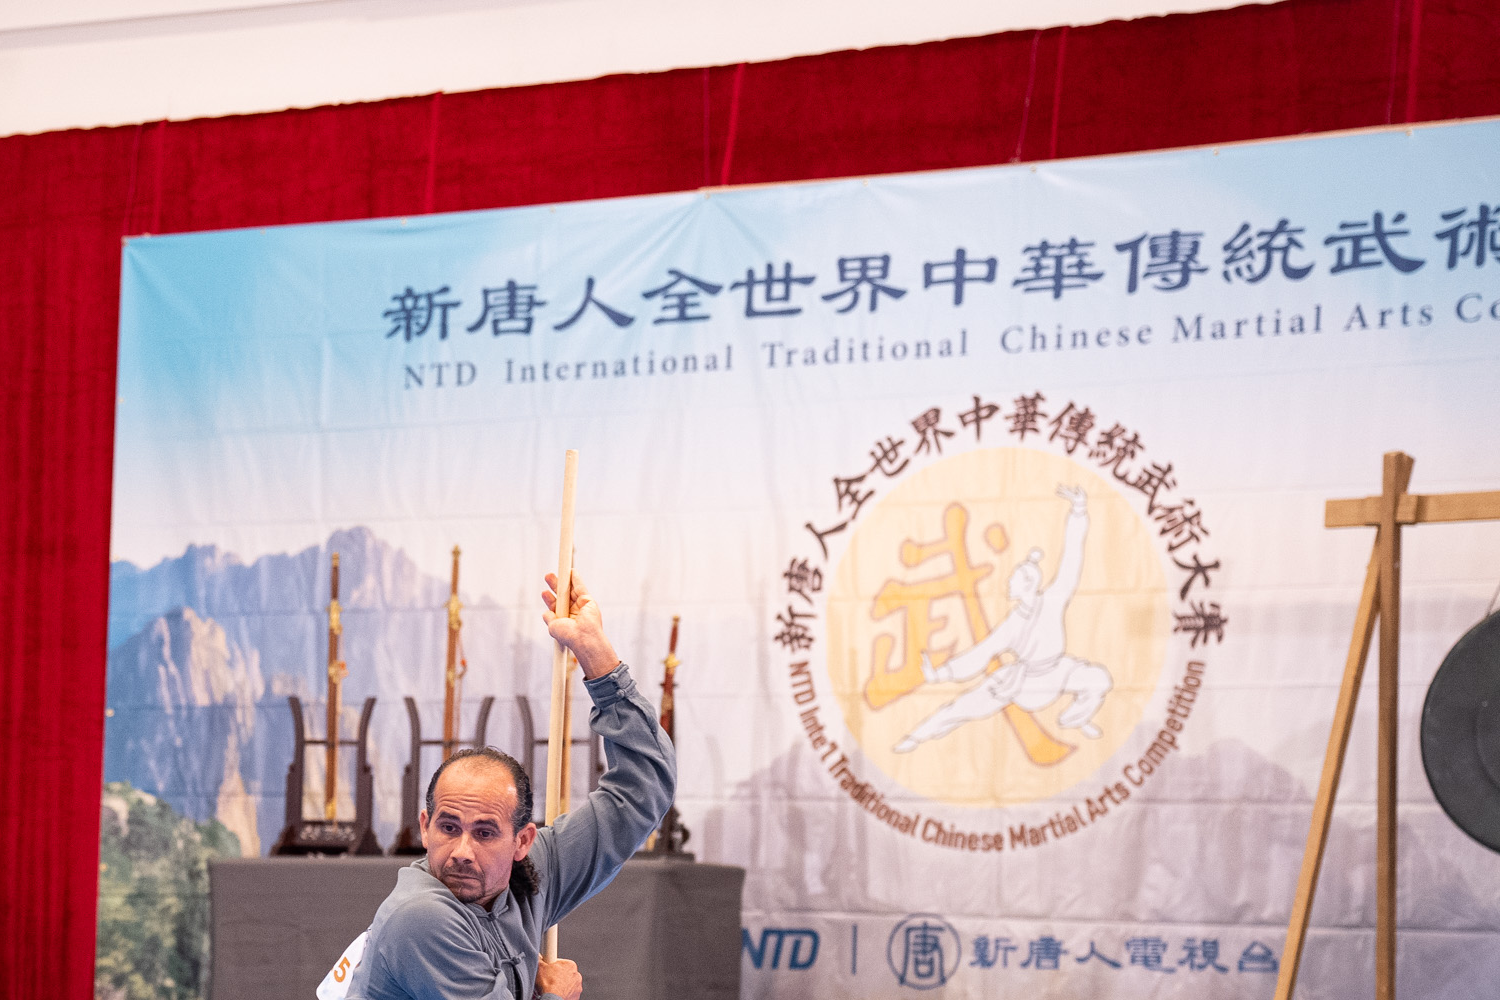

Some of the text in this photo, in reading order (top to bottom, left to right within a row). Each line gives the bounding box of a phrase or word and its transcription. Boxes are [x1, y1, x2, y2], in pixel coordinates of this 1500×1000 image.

[382, 202, 1500, 342] 新唐人全世界中華傳統武術
[403, 361, 478, 390] NTD
[504, 345, 734, 384] International
[762, 329, 969, 369] Traditional
[1000, 323, 1153, 355] Chinese
[1171, 304, 1323, 344] Martial
[1342, 302, 1434, 332] Arts
[789, 660, 816, 705] NTD
[828, 754, 920, 836] Traditional
[921, 817, 1005, 851] Chinese
[1009, 806, 1087, 849] Martial
[1085, 781, 1131, 822] Arts
[1122, 660, 1206, 787] Competition
[742, 927, 821, 971] NTD
